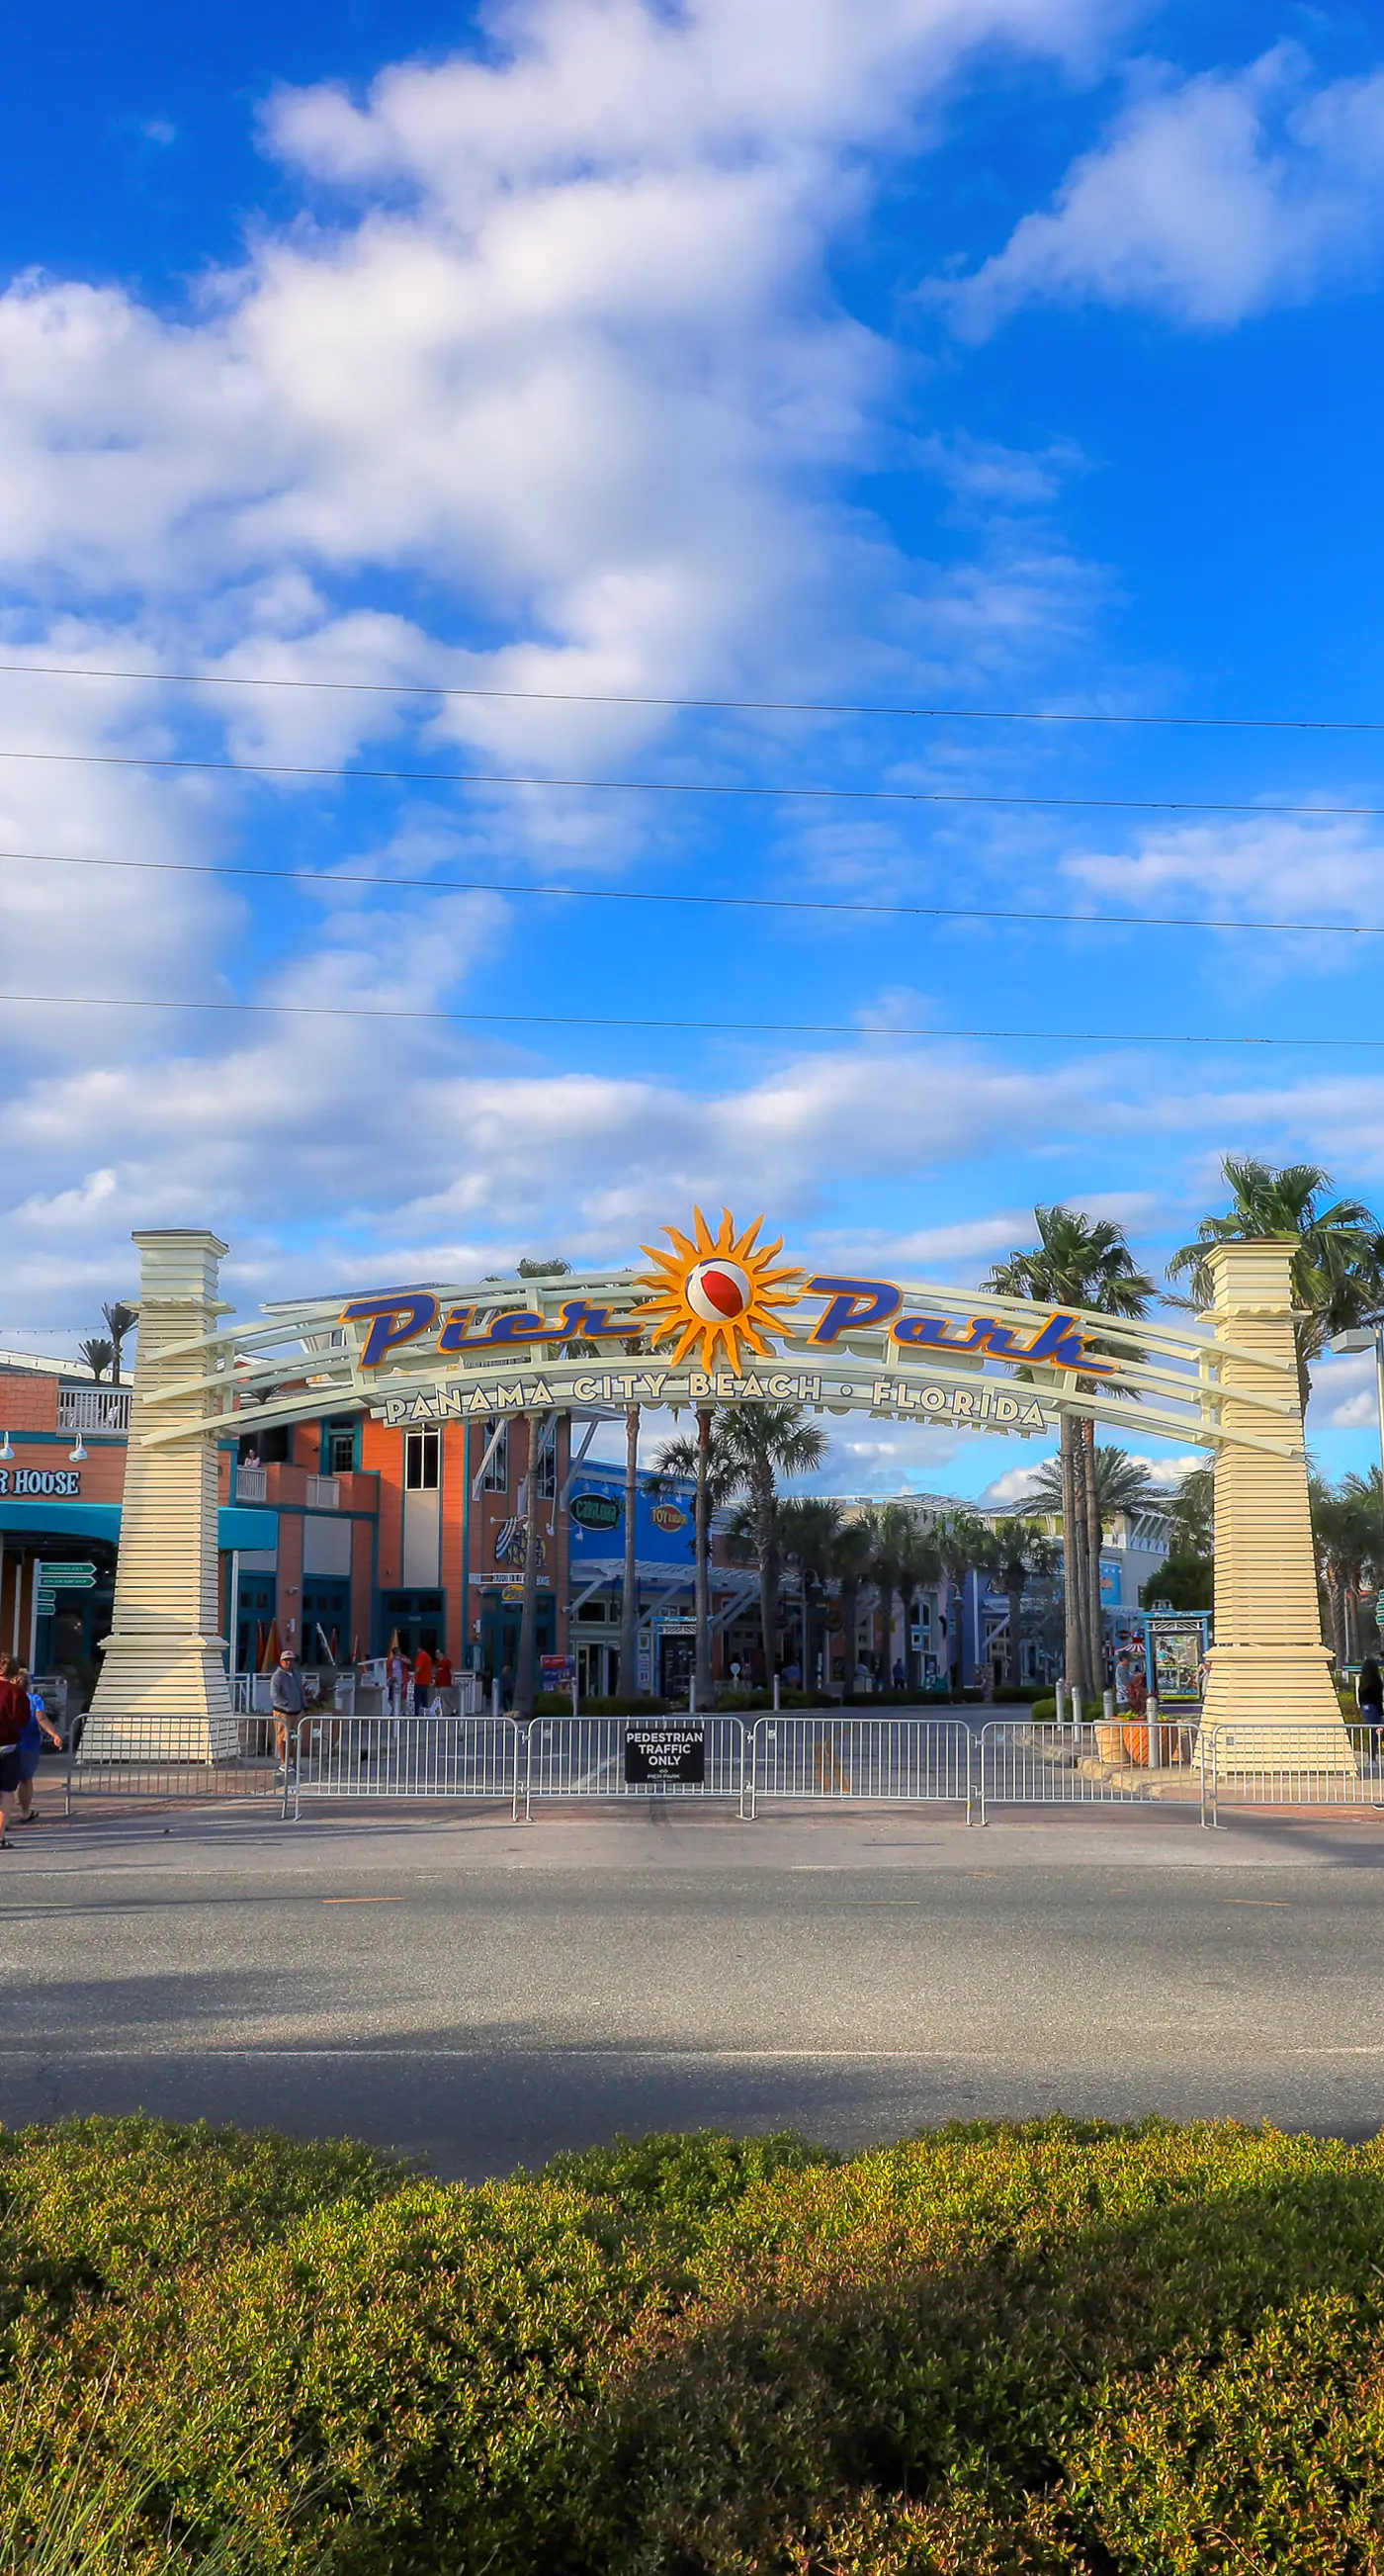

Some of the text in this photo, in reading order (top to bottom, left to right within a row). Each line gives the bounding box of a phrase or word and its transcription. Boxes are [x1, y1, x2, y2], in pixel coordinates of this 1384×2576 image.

[338, 1274, 1122, 1377] Pier Park
[385, 1371, 1046, 1428] PANAMA CITY BEACH FLORIDA
[13, 1469, 80, 1495] HOUSE
[652, 1508, 667, 1523] TOY
[627, 1732, 703, 1742] PEDESTRIAN
[639, 1744, 691, 1754] TRAFFIC
[649, 1755, 681, 1766] ONLY
